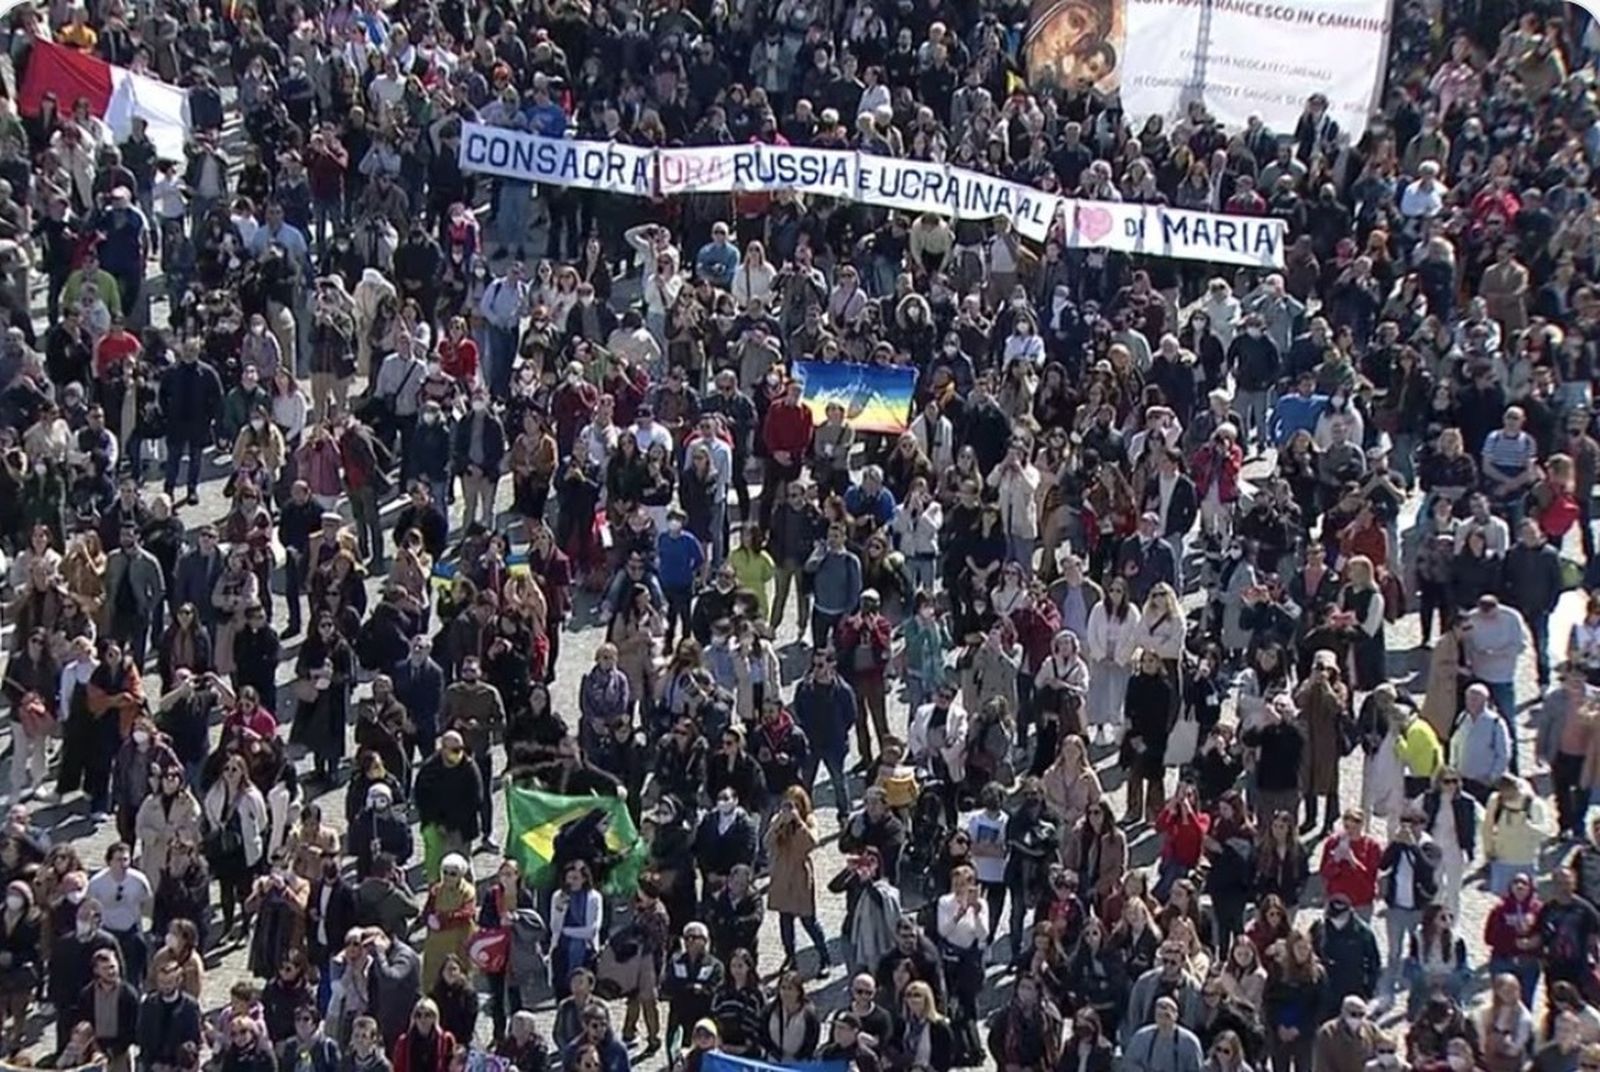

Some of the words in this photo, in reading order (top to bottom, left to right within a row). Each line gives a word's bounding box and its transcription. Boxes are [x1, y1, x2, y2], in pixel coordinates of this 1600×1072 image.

[1297, 10, 1315, 24] IN
[1317, 12, 1391, 34] CAMMINO
[466, 133, 649, 188] CONSACRA
[733, 149, 849, 188] RUSSIA
[858, 169, 872, 189] E
[879, 166, 1013, 214] UCRAINA
[1016, 198, 1045, 225] AL
[1124, 218, 1145, 238] DI
[1162, 213, 1274, 254] MARIA
